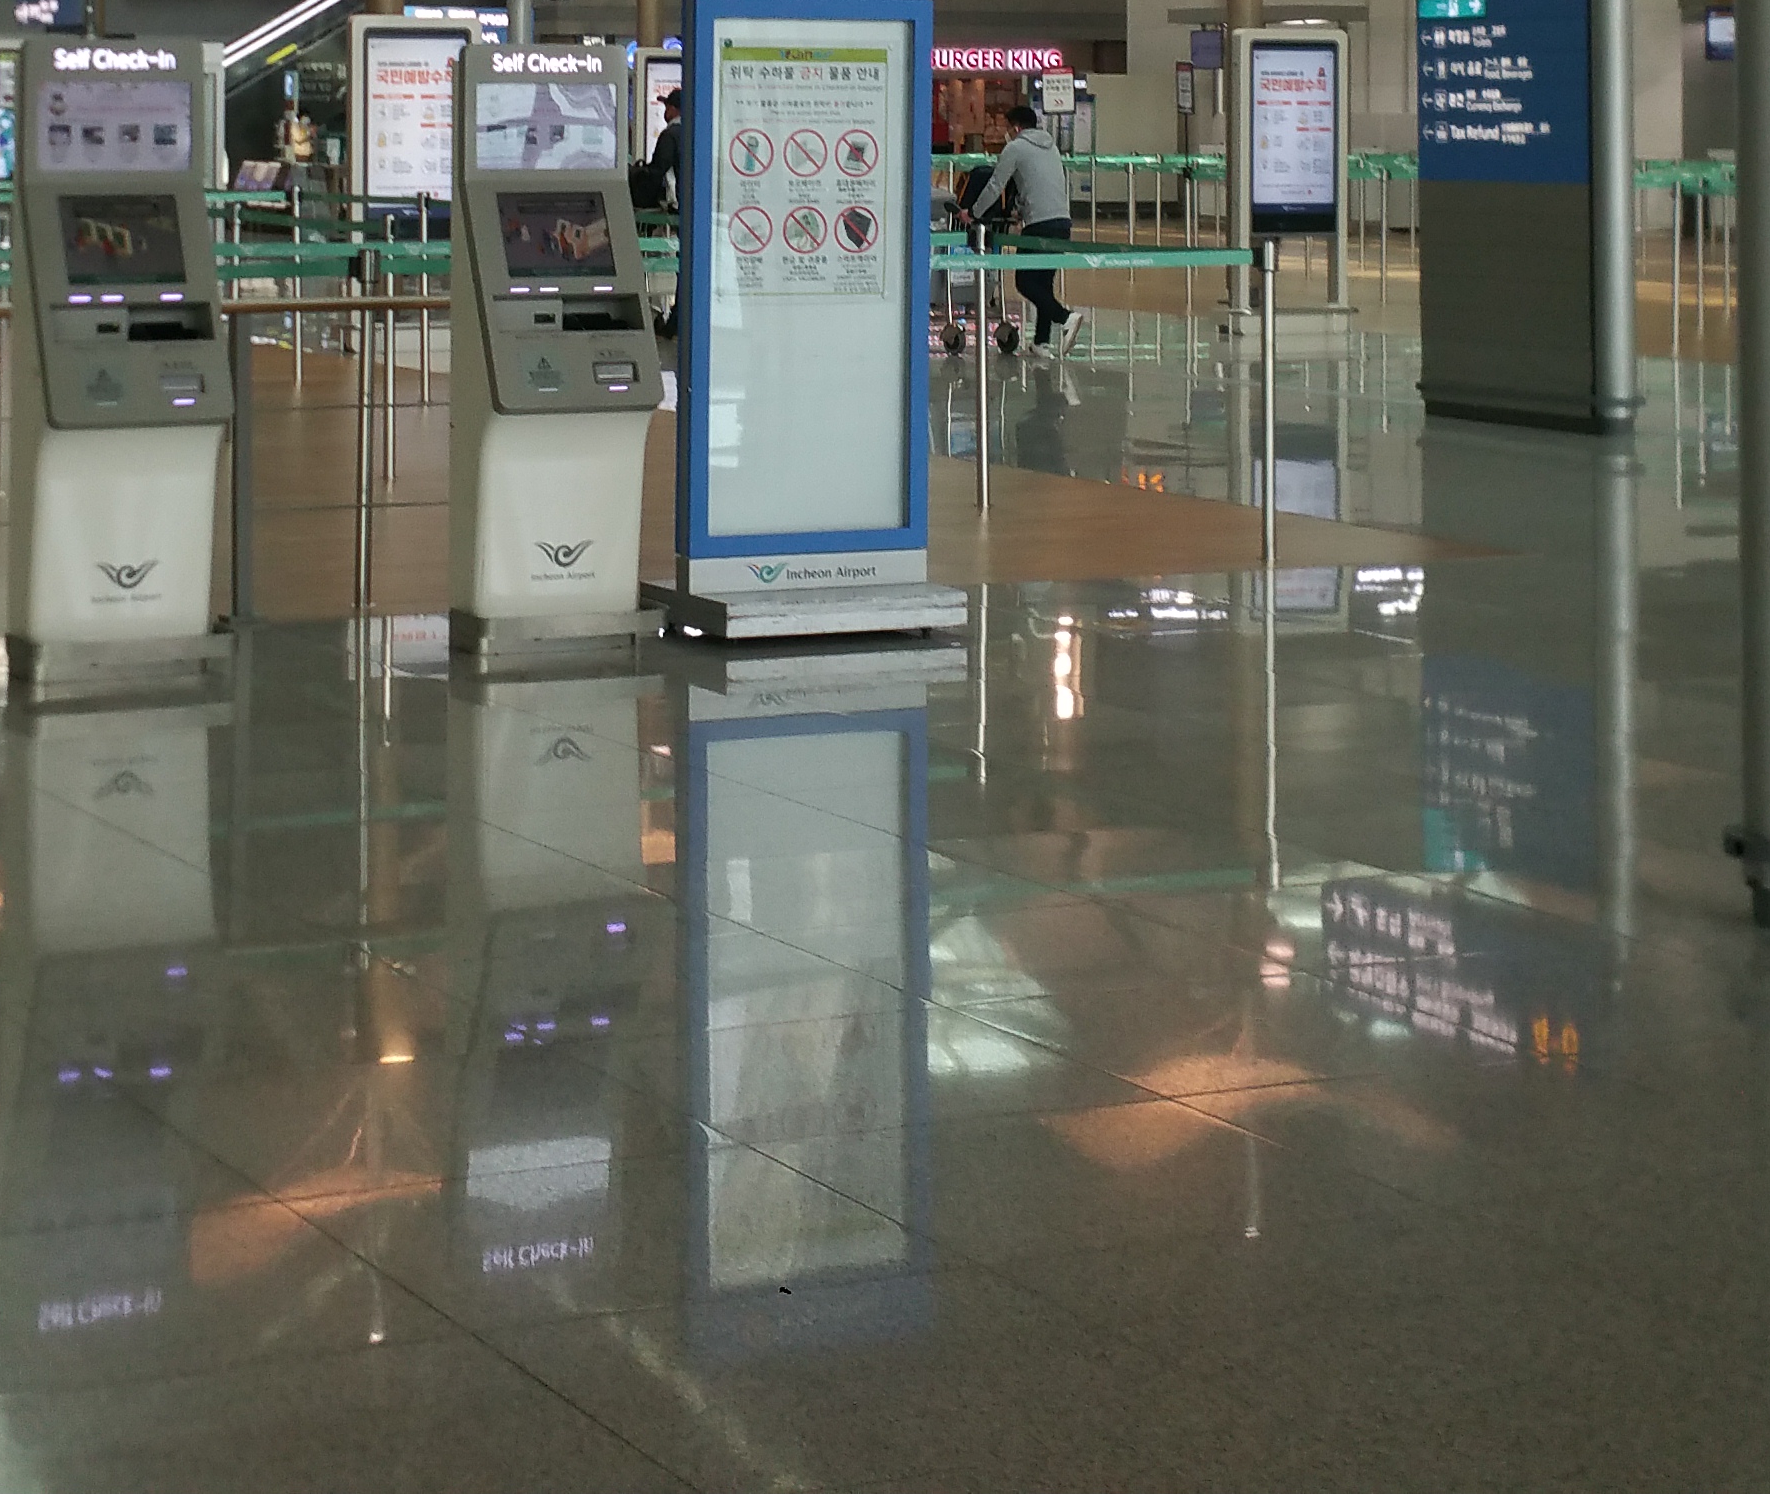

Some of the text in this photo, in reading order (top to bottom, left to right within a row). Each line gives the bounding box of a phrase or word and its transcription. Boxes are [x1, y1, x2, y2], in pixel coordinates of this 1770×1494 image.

[53, 47, 91, 71] Self
[492, 53, 526, 73] Self
[1007, 48, 1063, 70] KING
[759, 65, 795, 81] 수하물
[800, 65, 824, 81] 금지
[856, 66, 881, 81] 안내
[786, 565, 877, 581] Incheon Airport
